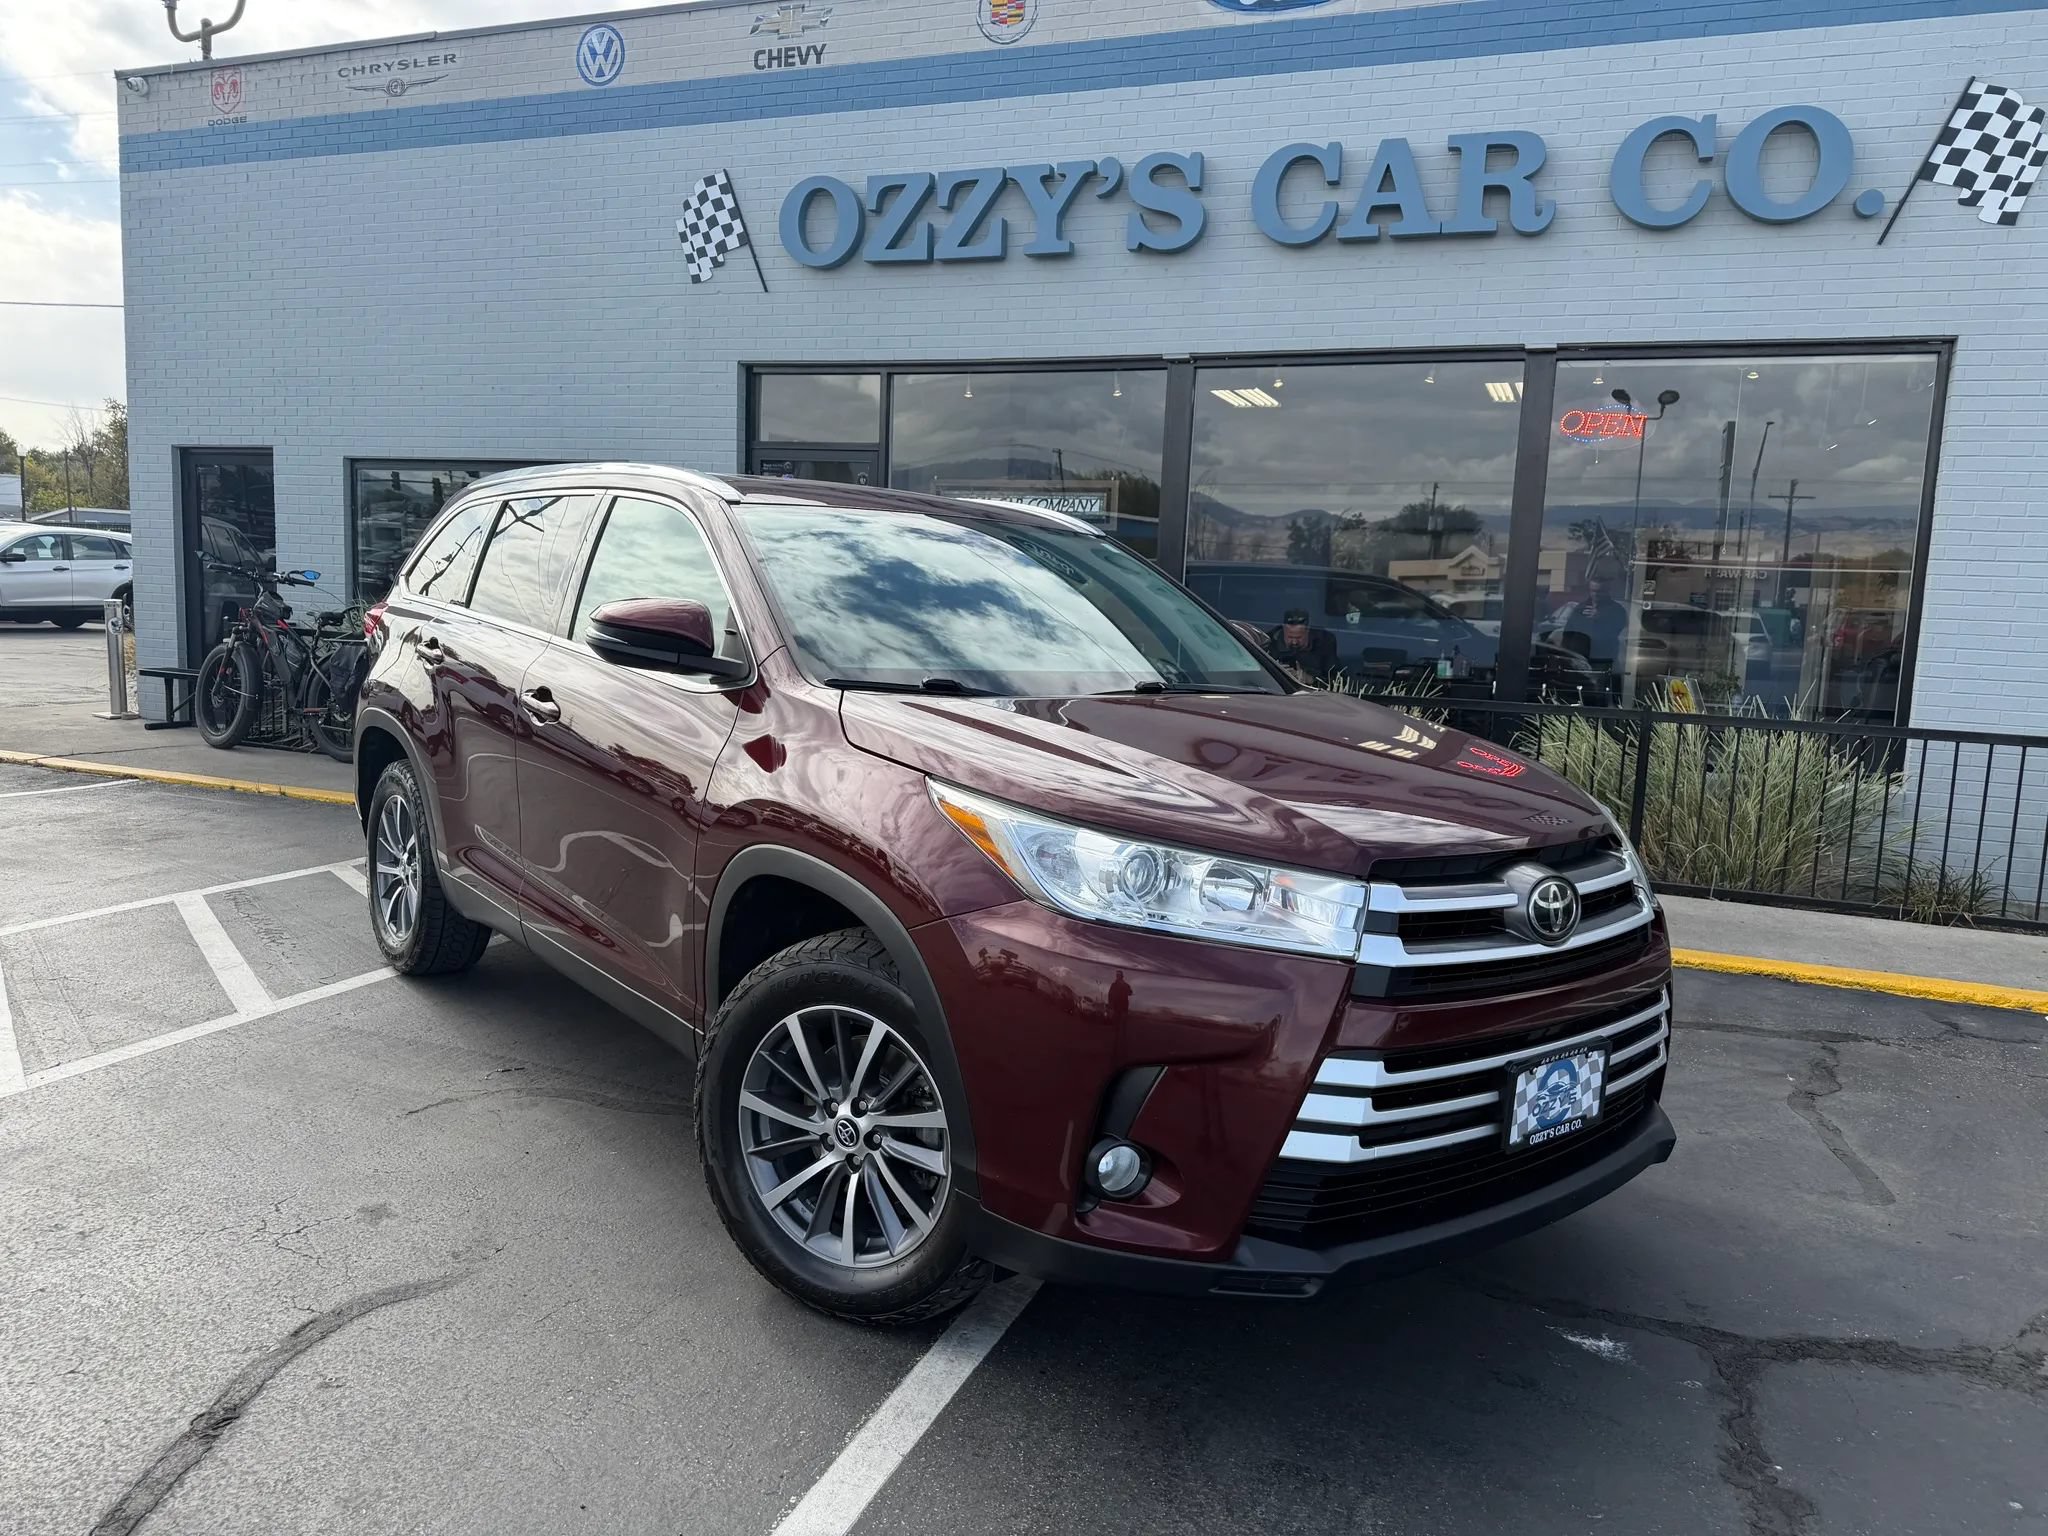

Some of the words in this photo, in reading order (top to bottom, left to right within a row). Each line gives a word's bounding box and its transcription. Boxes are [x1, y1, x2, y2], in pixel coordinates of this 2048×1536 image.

[338, 53, 457, 77] CHRYSLER
[754, 43, 827, 70] CHEVY
[207, 116, 248, 126] DODGE
[778, 152, 1207, 270] OZZY'S
[1251, 130, 1557, 249] CAR
[1608, 104, 1886, 232] CO.
[1560, 409, 1648, 438] OPEN
[1028, 498, 1098, 512] COMPANY
[1530, 1127, 1555, 1145] OZZY'S
[1555, 1122, 1570, 1136] CAR
[1570, 1118, 1583, 1131] CO.
